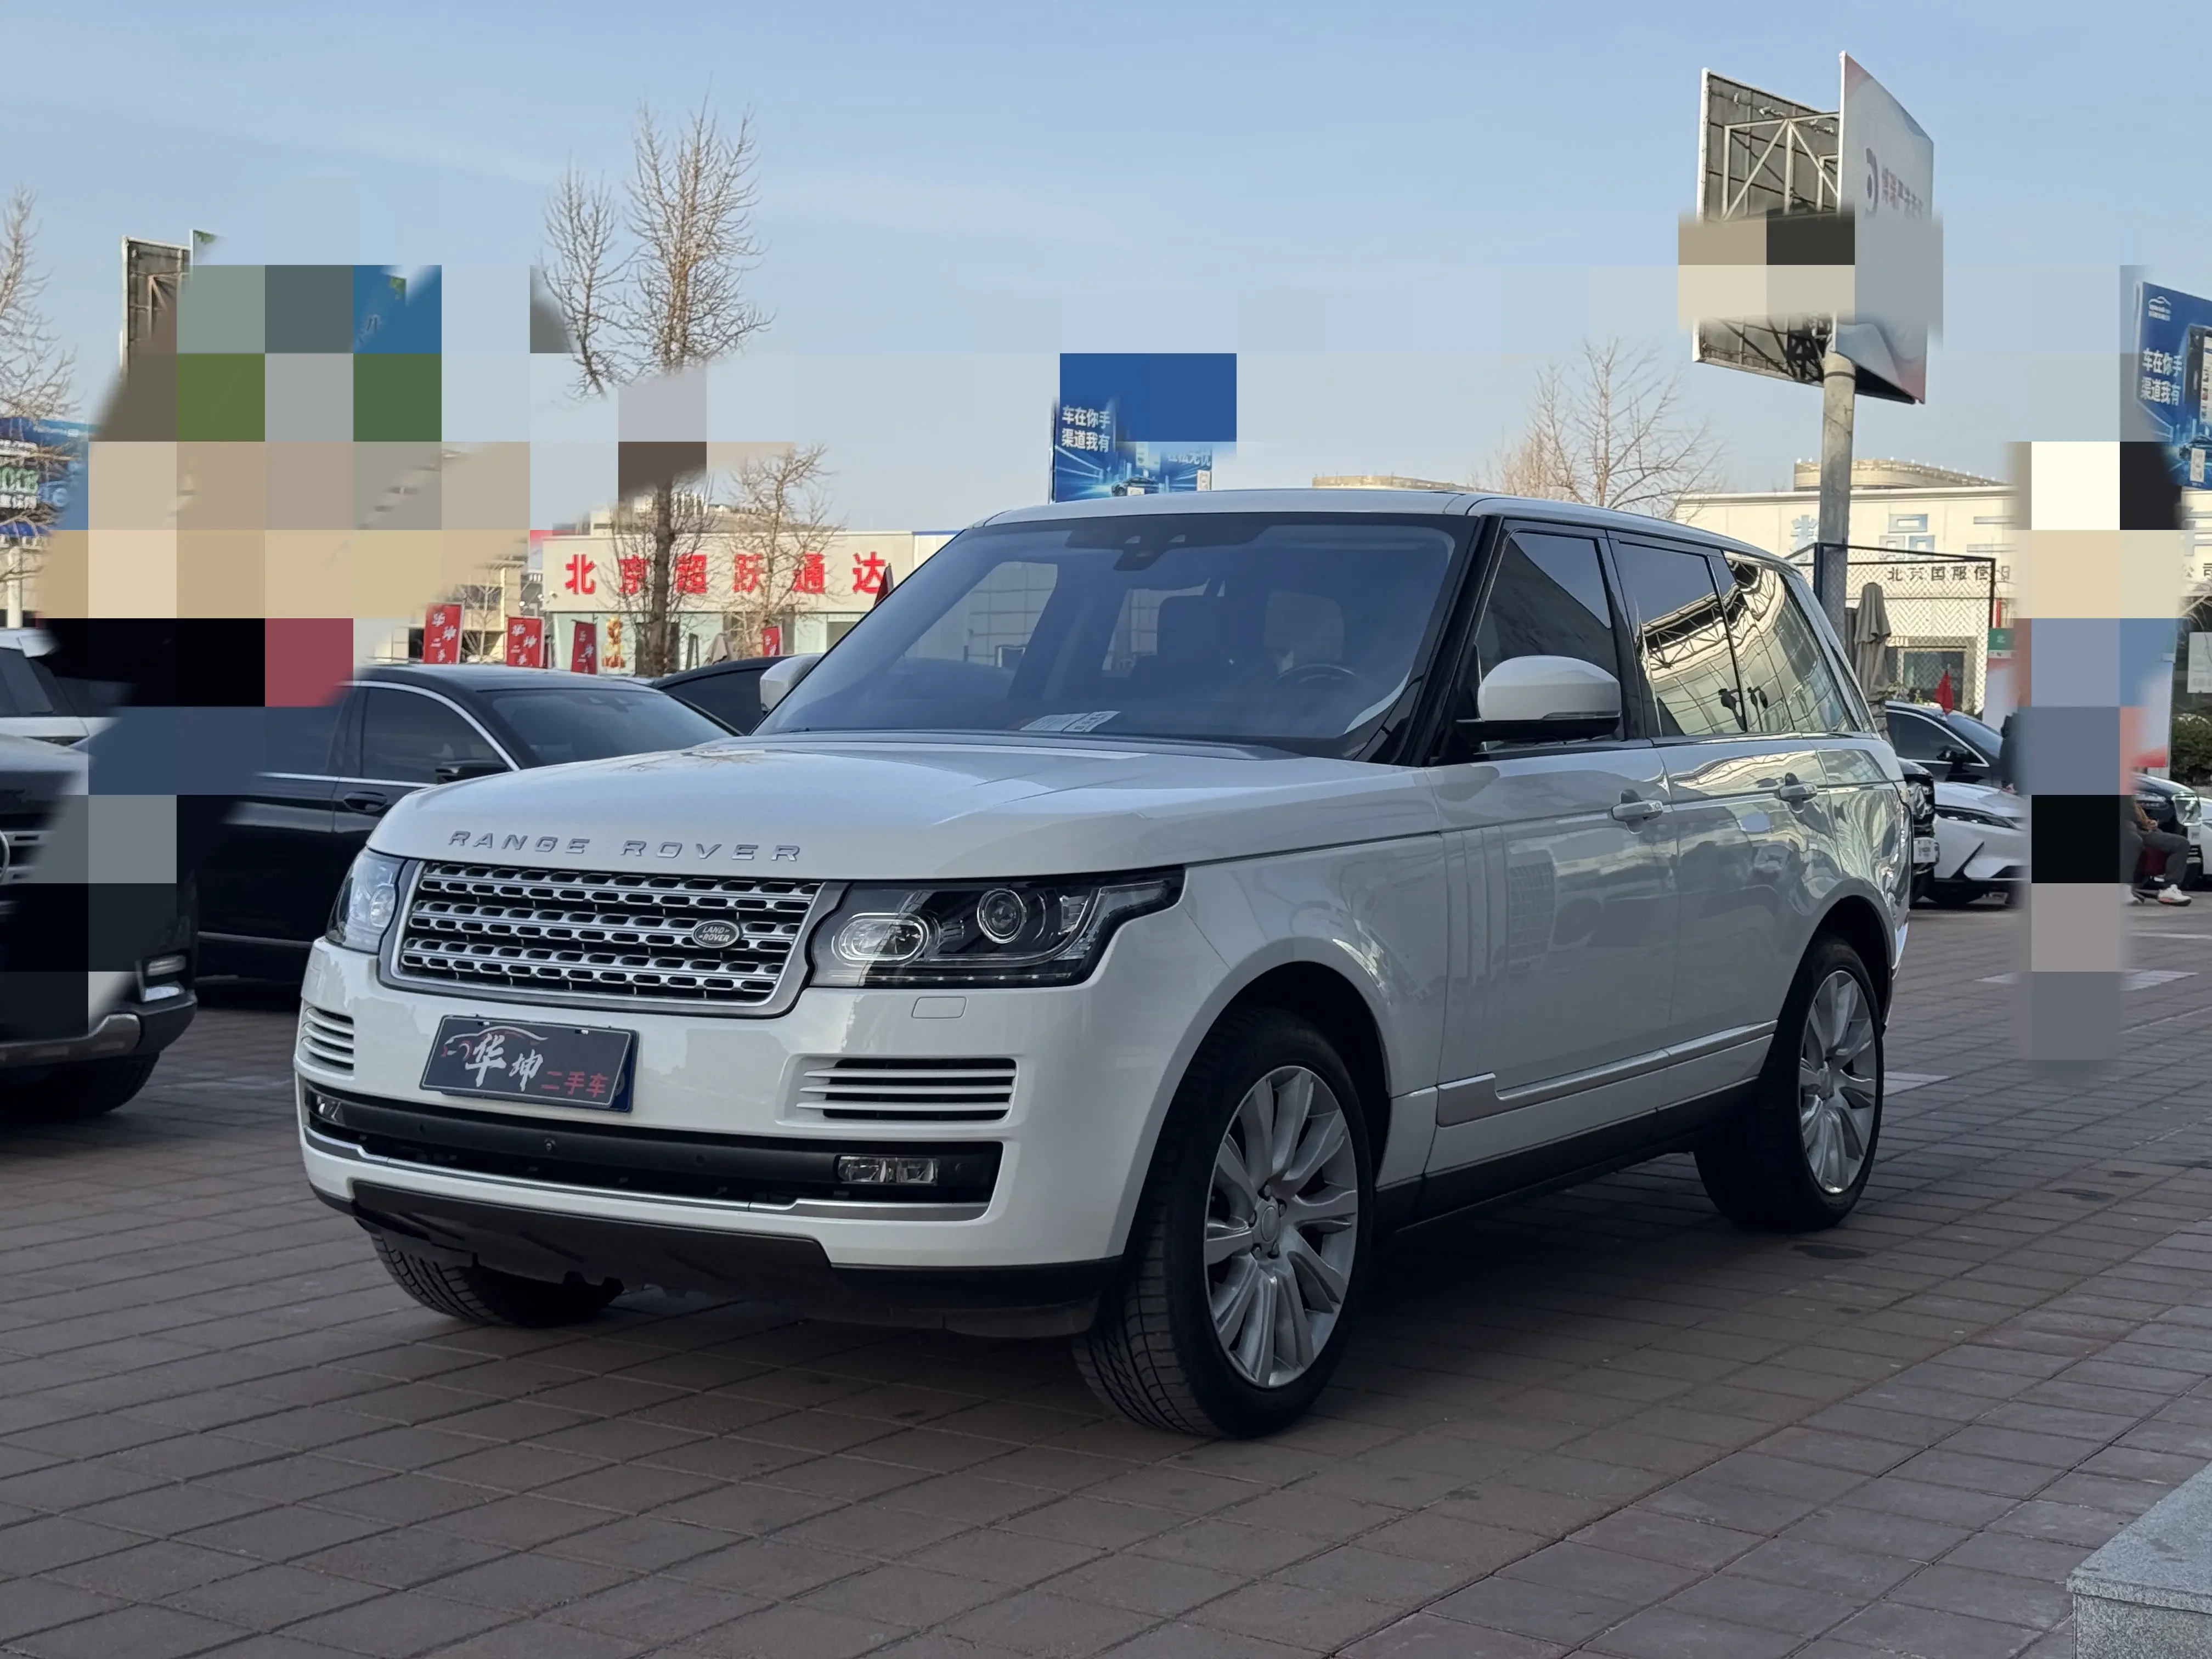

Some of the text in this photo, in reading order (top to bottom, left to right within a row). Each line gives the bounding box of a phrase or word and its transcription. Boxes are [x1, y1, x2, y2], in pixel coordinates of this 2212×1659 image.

[2142, 347, 2183, 377] 车在你手
[1062, 405, 1111, 430] 车在你手
[1061, 427, 1111, 453] 渠道我有
[565, 551, 887, 595] 北京超跃通达
[448, 830, 800, 862] RANGE ROVER
[702, 933, 730, 942] ROVER
[465, 1032, 608, 1098] 华坤 二手车
